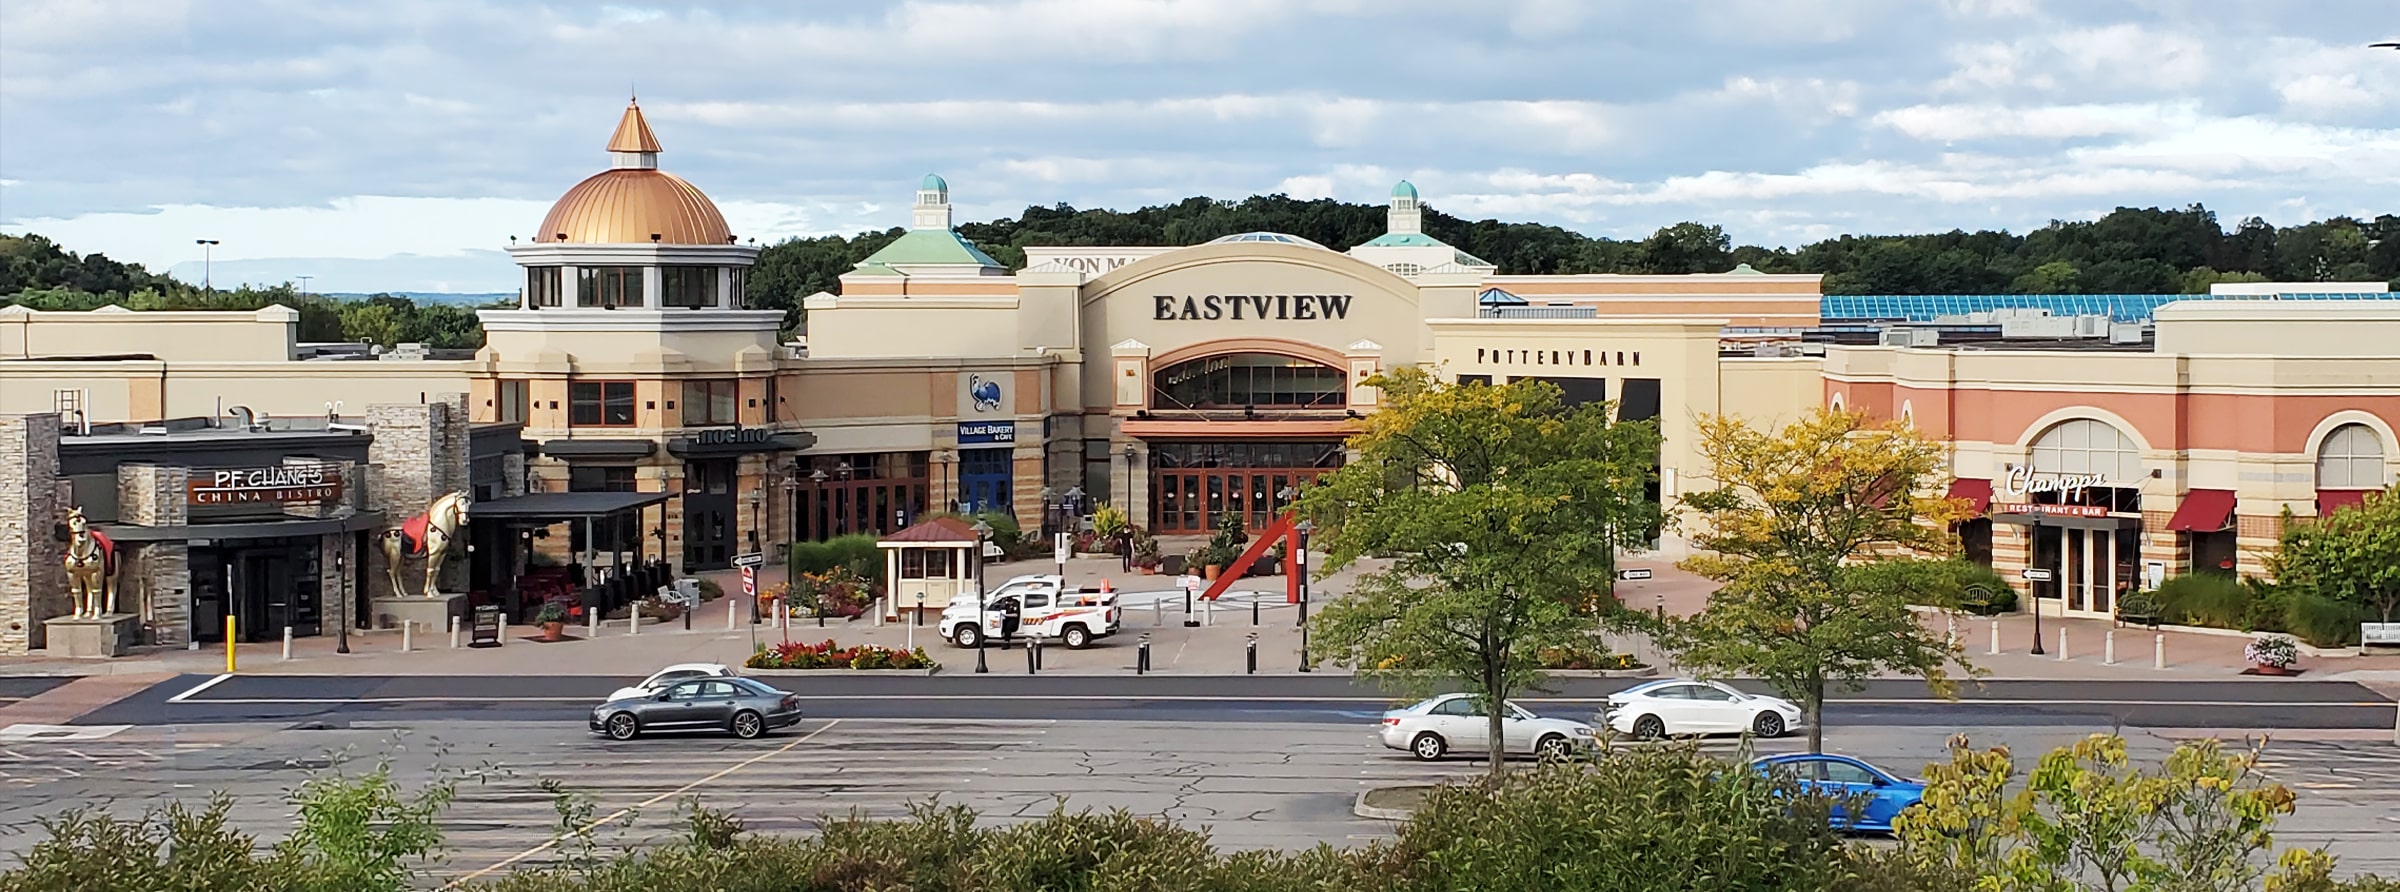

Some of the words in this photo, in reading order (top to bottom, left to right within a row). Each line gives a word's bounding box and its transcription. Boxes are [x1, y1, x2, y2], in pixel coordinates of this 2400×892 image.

[1153, 295, 1353, 320] EASTVIEW
[699, 428, 768, 445] nocino
[960, 426, 987, 435] VILLAGE
[987, 425, 1014, 434] BAKERY
[248, 465, 323, 488] CHANG'S
[2006, 464, 2106, 505] Champps
[197, 491, 261, 502] CHINA
[276, 487, 332, 499] BISTRO
[2009, 504, 2068, 515] RESTRANT
[2082, 507, 2101, 516] BAR
